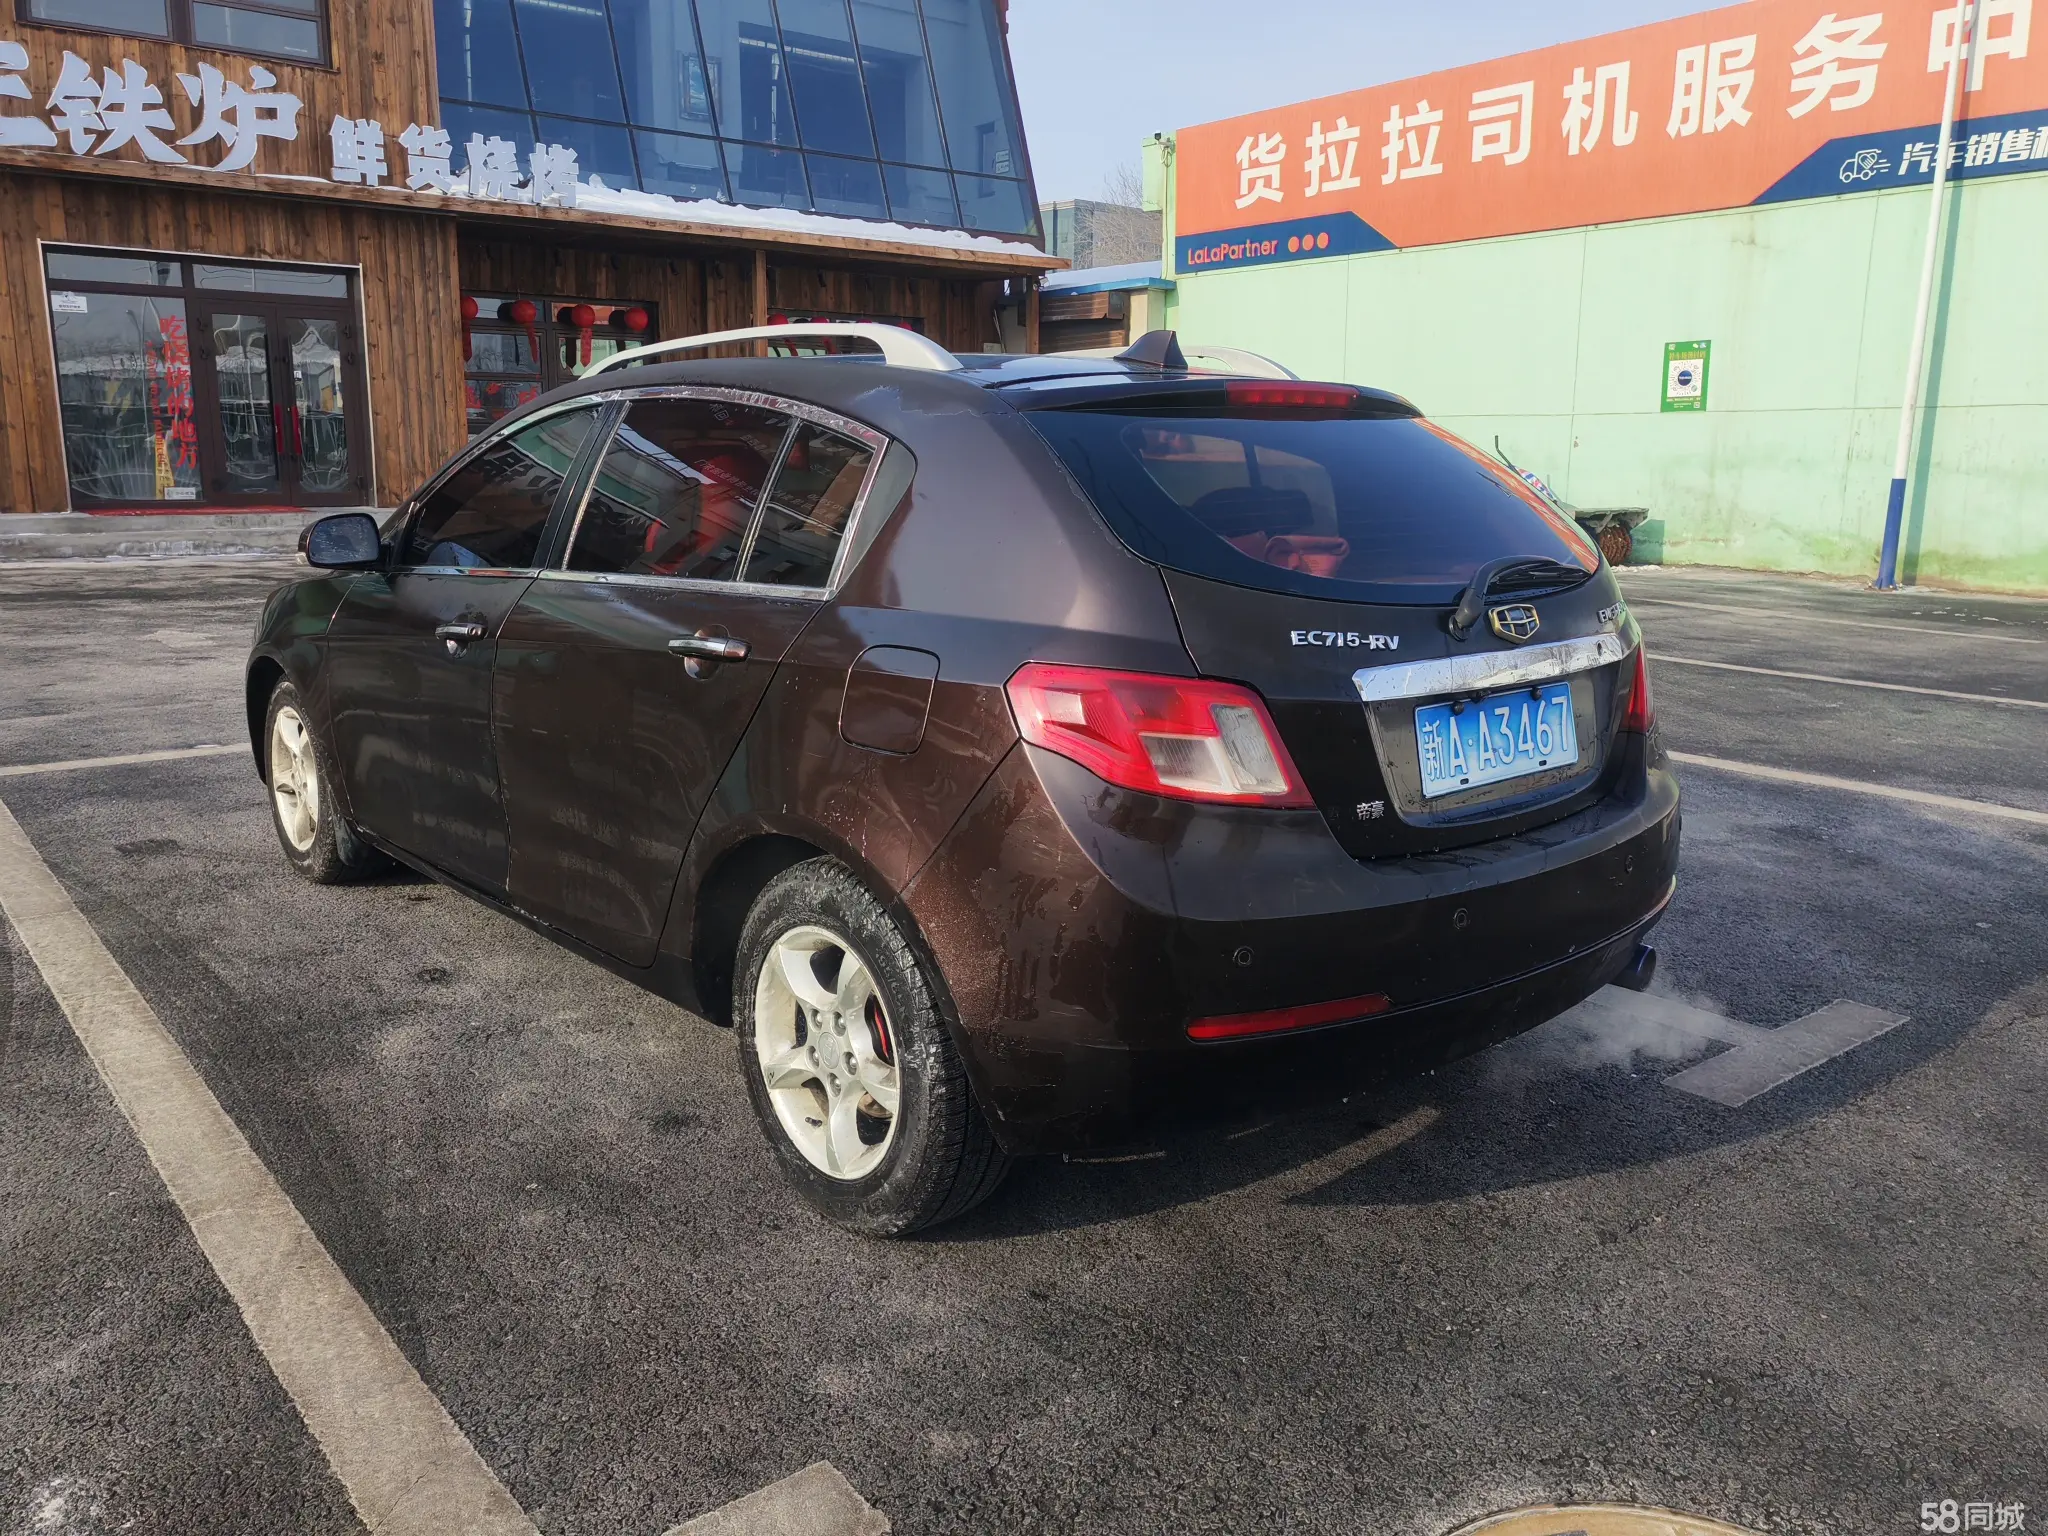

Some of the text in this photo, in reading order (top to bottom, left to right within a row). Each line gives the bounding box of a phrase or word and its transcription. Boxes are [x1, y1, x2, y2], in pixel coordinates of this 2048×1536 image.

[329, 114, 580, 208] 鲜货烧烤
[1187, 239, 1279, 265] LaLaPartner
[160, 315, 198, 469] 吃烧烤的地方
[1290, 630, 1400, 650] EC715-RV
[1356, 800, 1385, 820] 帝豪
